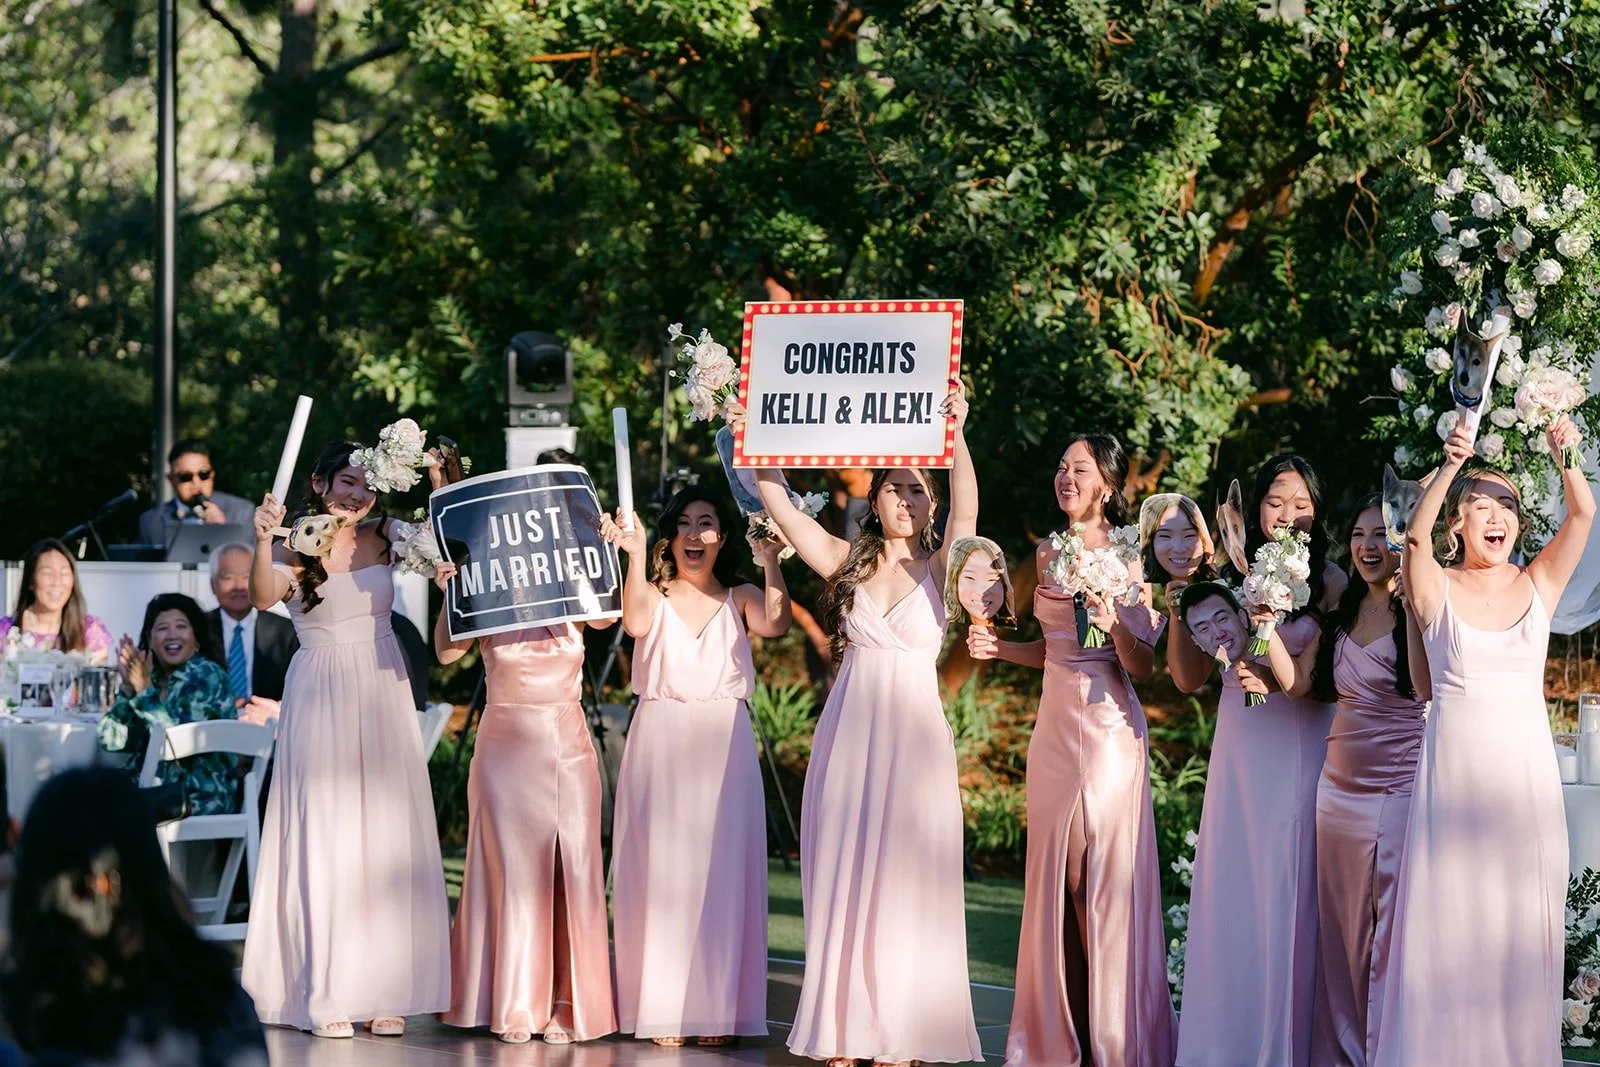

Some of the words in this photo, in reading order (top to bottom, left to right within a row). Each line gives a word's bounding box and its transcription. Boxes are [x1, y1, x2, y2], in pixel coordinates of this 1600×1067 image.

[784, 341, 916, 375] CONGRATS
[760, 392, 827, 425] KELLI
[835, 395, 853, 424] &
[861, 392, 933, 425] ALEX!
[489, 506, 561, 549] JUST
[460, 546, 603, 598] MARRIED
